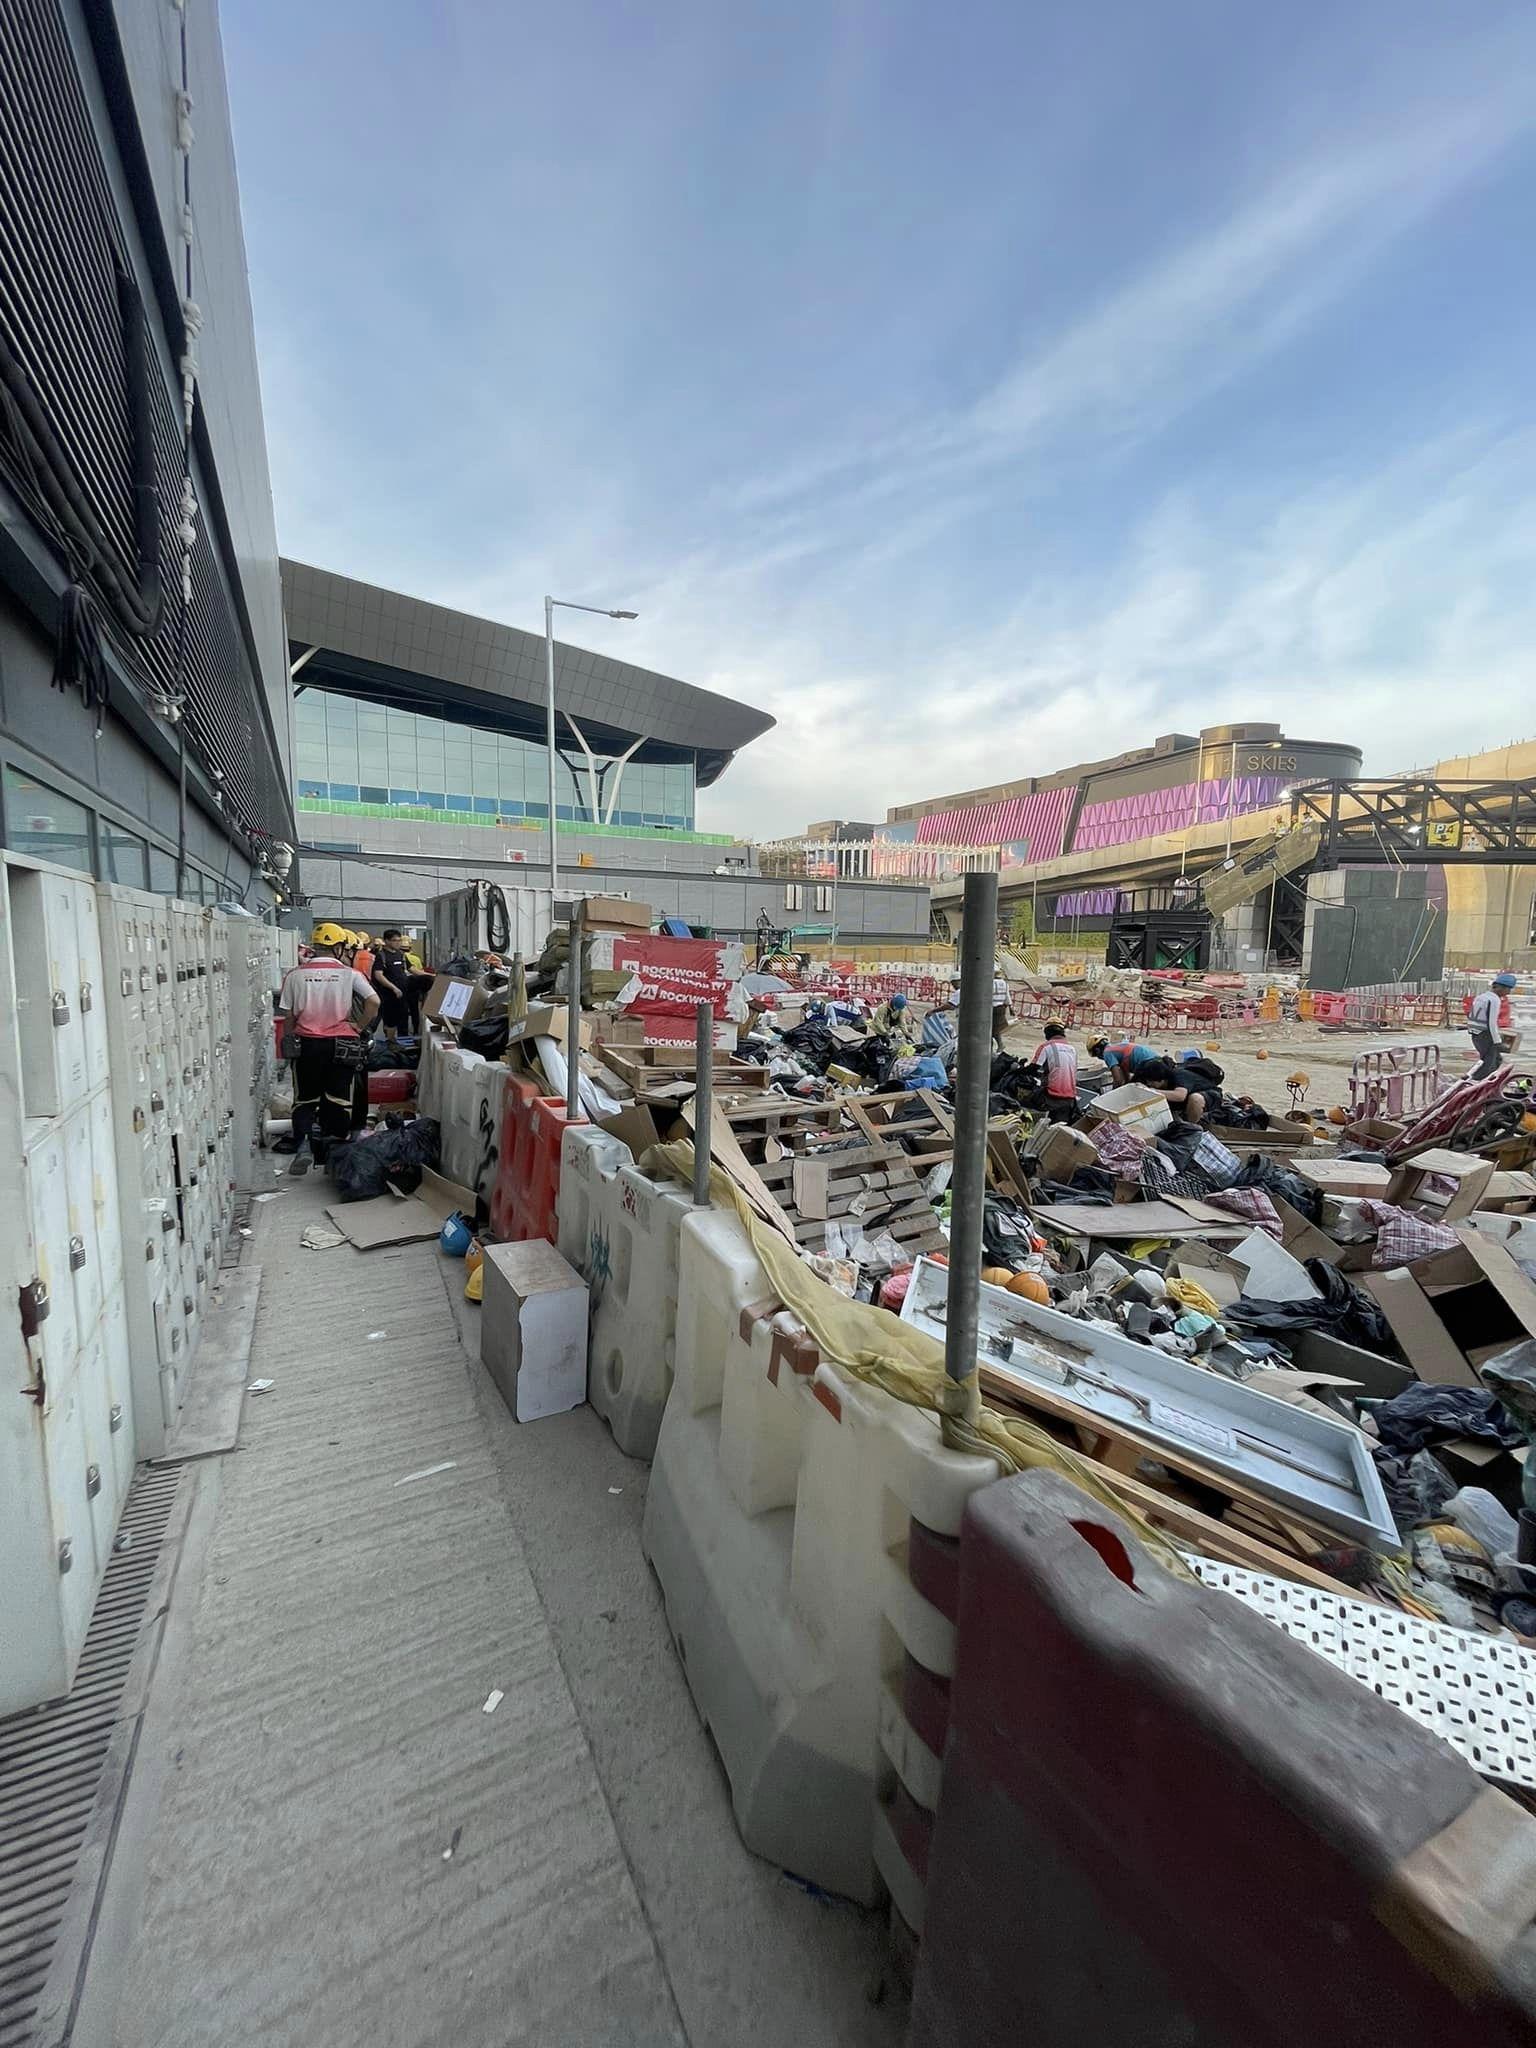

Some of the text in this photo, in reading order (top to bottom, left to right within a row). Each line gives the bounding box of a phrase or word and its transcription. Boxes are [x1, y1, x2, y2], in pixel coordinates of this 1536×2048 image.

[1247, 755, 1297, 771] SKIES
[1436, 824, 1454, 833] P4
[641, 965, 708, 979] ROCKWOOL
